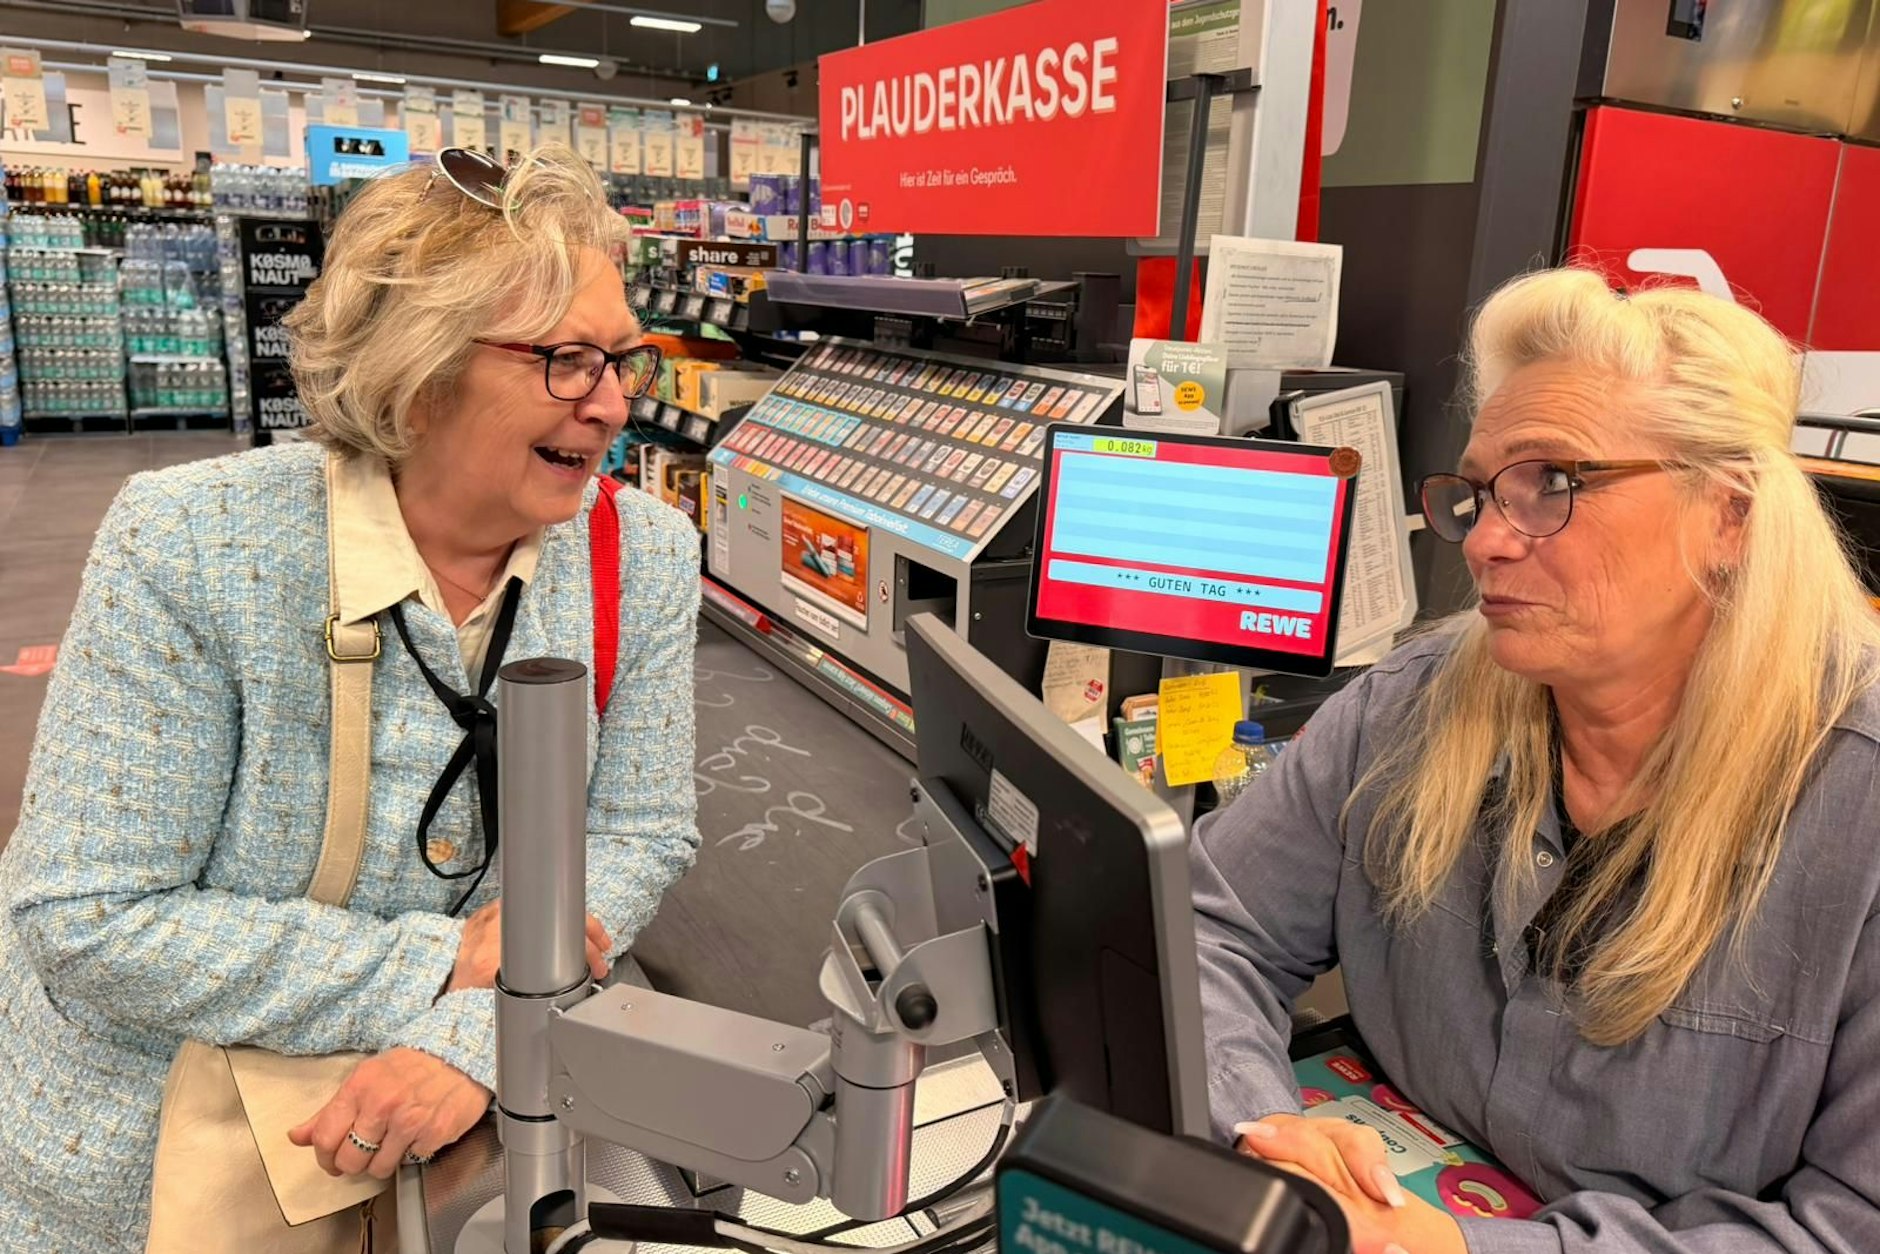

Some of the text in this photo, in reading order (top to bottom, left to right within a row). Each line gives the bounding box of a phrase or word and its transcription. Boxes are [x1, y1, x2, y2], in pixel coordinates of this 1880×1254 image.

[841, 36, 1119, 142] PLAUDERKASSE
[899, 164, 1017, 188] Hier ist Zeit für ein Gespräch.
[688, 246, 739, 264] share
[251, 268, 300, 286] NAUT
[1161, 360, 1180, 374] für
[1148, 576, 1226, 597] GUTEN TAG
[1239, 610, 1313, 639] REWE
[714, 791, 854, 851] die
[1021, 1196, 1093, 1247] Jetzt
